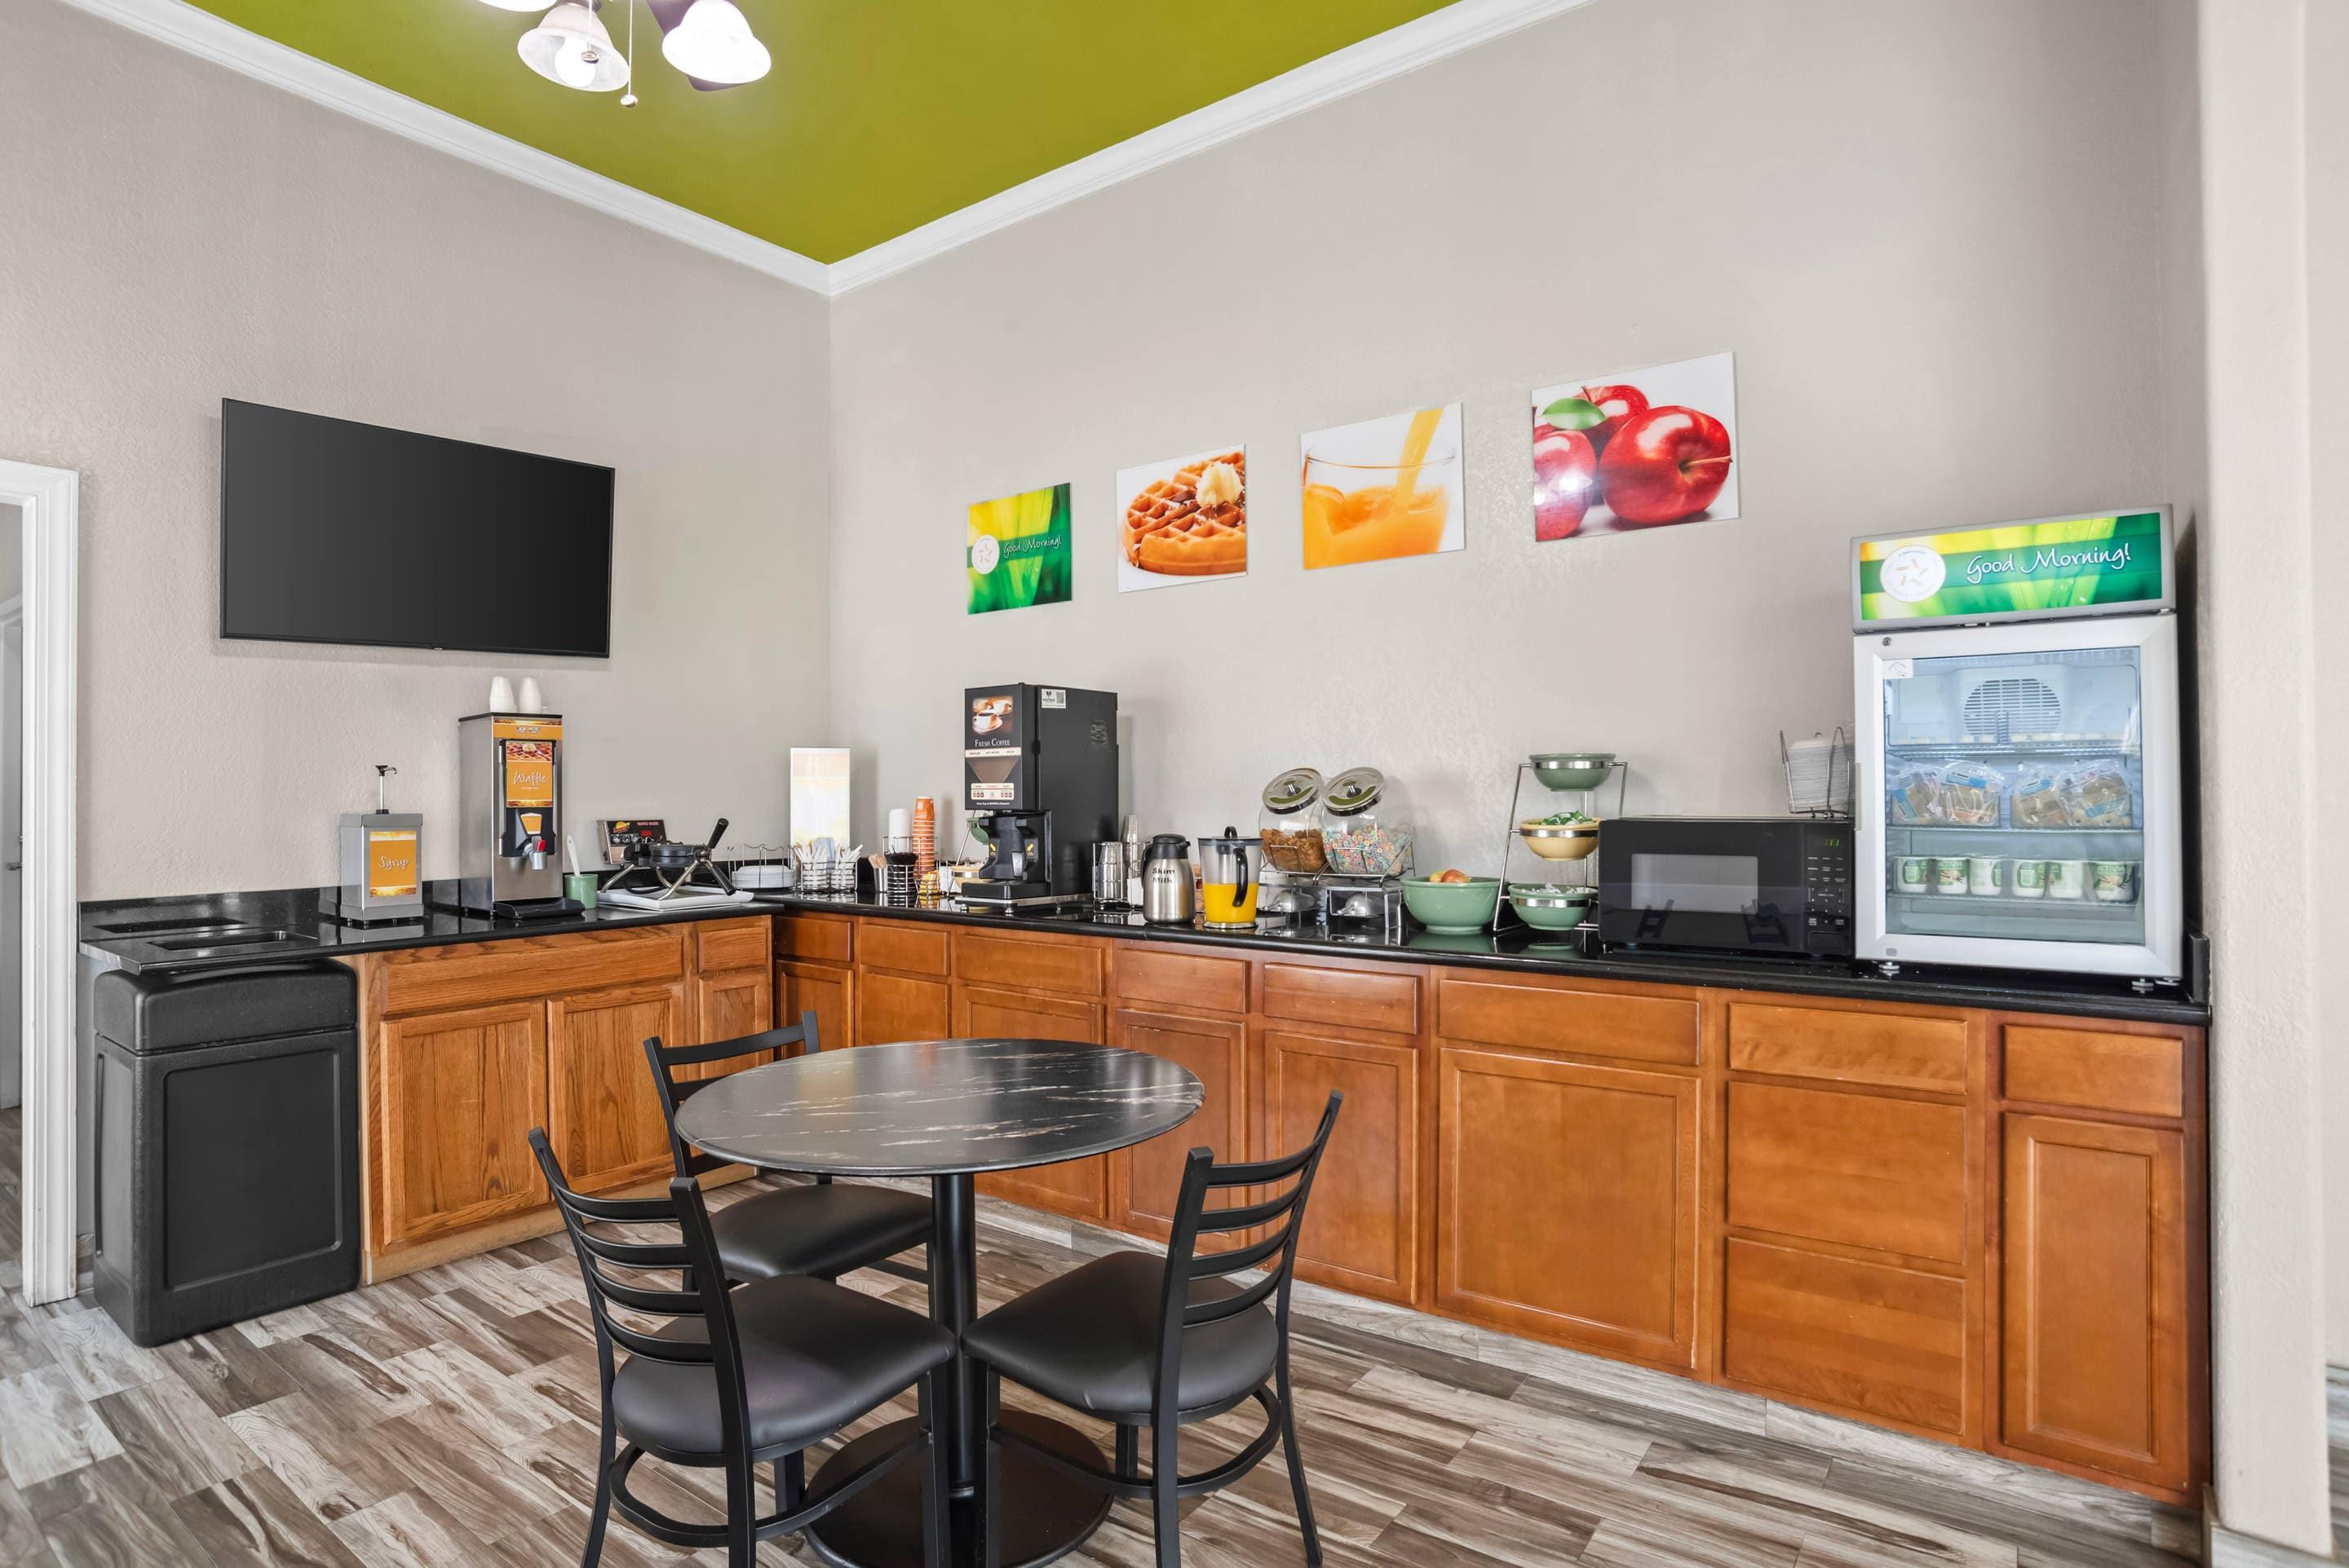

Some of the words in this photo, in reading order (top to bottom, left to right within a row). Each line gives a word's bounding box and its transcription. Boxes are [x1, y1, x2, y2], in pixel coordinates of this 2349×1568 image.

[1003, 541, 1021, 559] Good
[1022, 534, 1061, 550] Morning!
[1966, 554, 2015, 584] Good
[2020, 542, 2132, 573] Morning!
[975, 739, 990, 747] FRESH
[991, 738, 1011, 746] COFFEE
[513, 771, 546, 786] Waffle
[378, 855, 410, 871] Syrup
